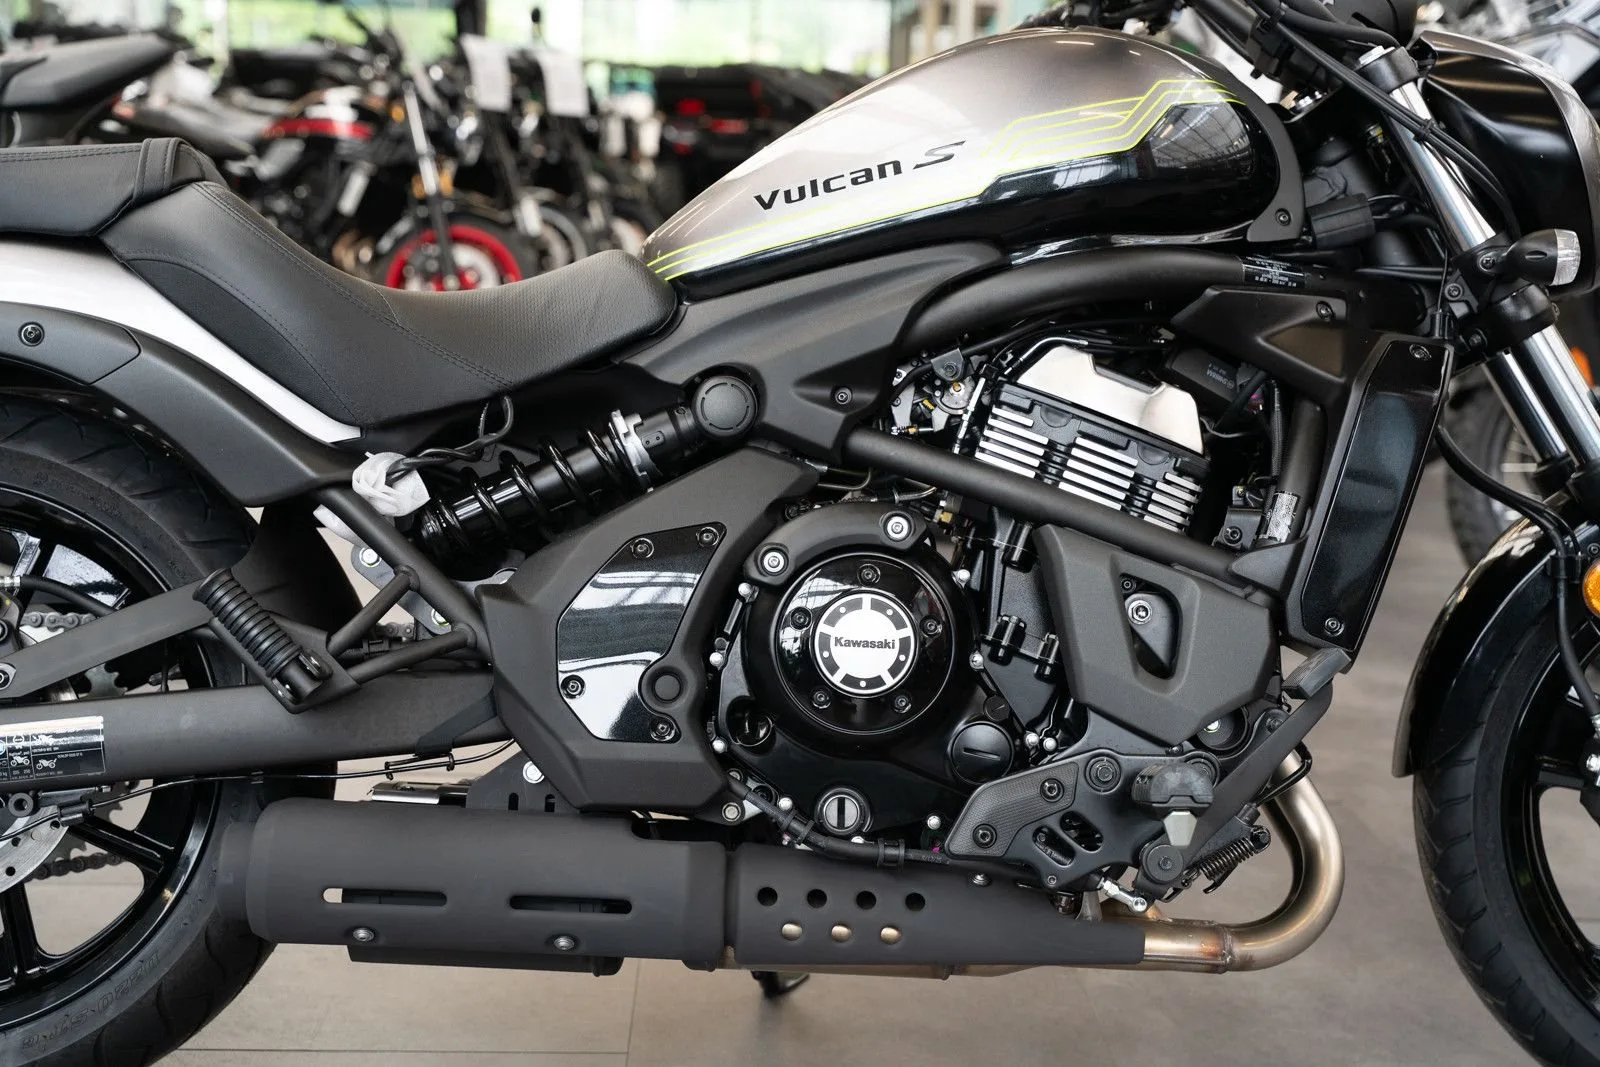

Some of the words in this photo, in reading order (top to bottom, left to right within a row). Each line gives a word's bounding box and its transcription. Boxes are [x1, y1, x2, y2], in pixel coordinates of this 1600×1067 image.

[753, 159, 903, 211] Vulcan
[912, 140, 966, 170] S
[834, 636, 896, 650] Kawasaki
